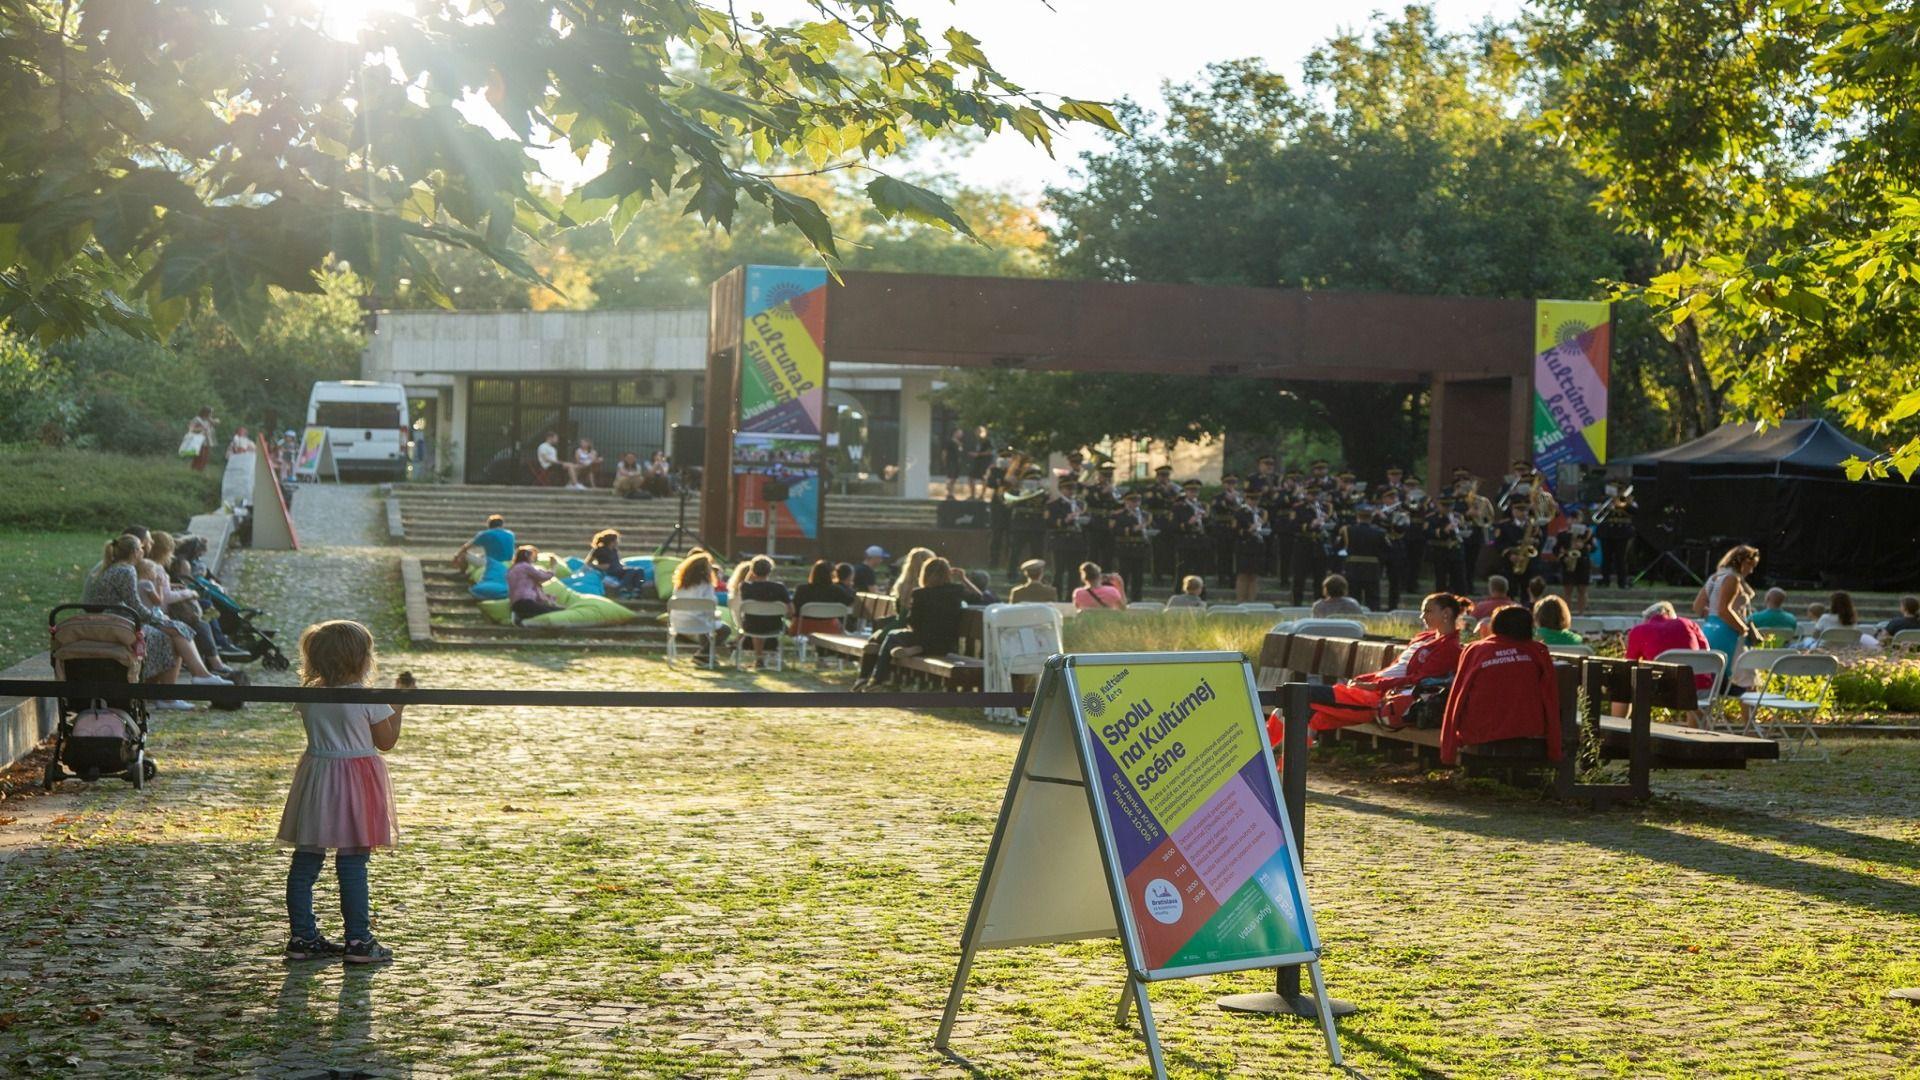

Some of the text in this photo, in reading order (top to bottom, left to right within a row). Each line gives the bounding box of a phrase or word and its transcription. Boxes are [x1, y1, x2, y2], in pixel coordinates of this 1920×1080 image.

[747, 340, 792, 405] summer
[752, 312, 814, 396] Cultural
[1541, 347, 1595, 427] Kultúrne
[742, 400, 776, 420] June
[1547, 394, 1577, 437] leto
[1100, 668, 1129, 695] Kultúrne
[1106, 688, 1122, 702] leto
[1102, 698, 1154, 745] Spolu
[1120, 677, 1216, 769] na Kultúrnej
[1136, 741, 1186, 791] scéne
[1112, 789, 1133, 817] Piatok
[1112, 773, 1159, 838] Sad Janka Kráľa
[1152, 898, 1178, 906] Bratislava
[1239, 921, 1256, 940] Vstup
